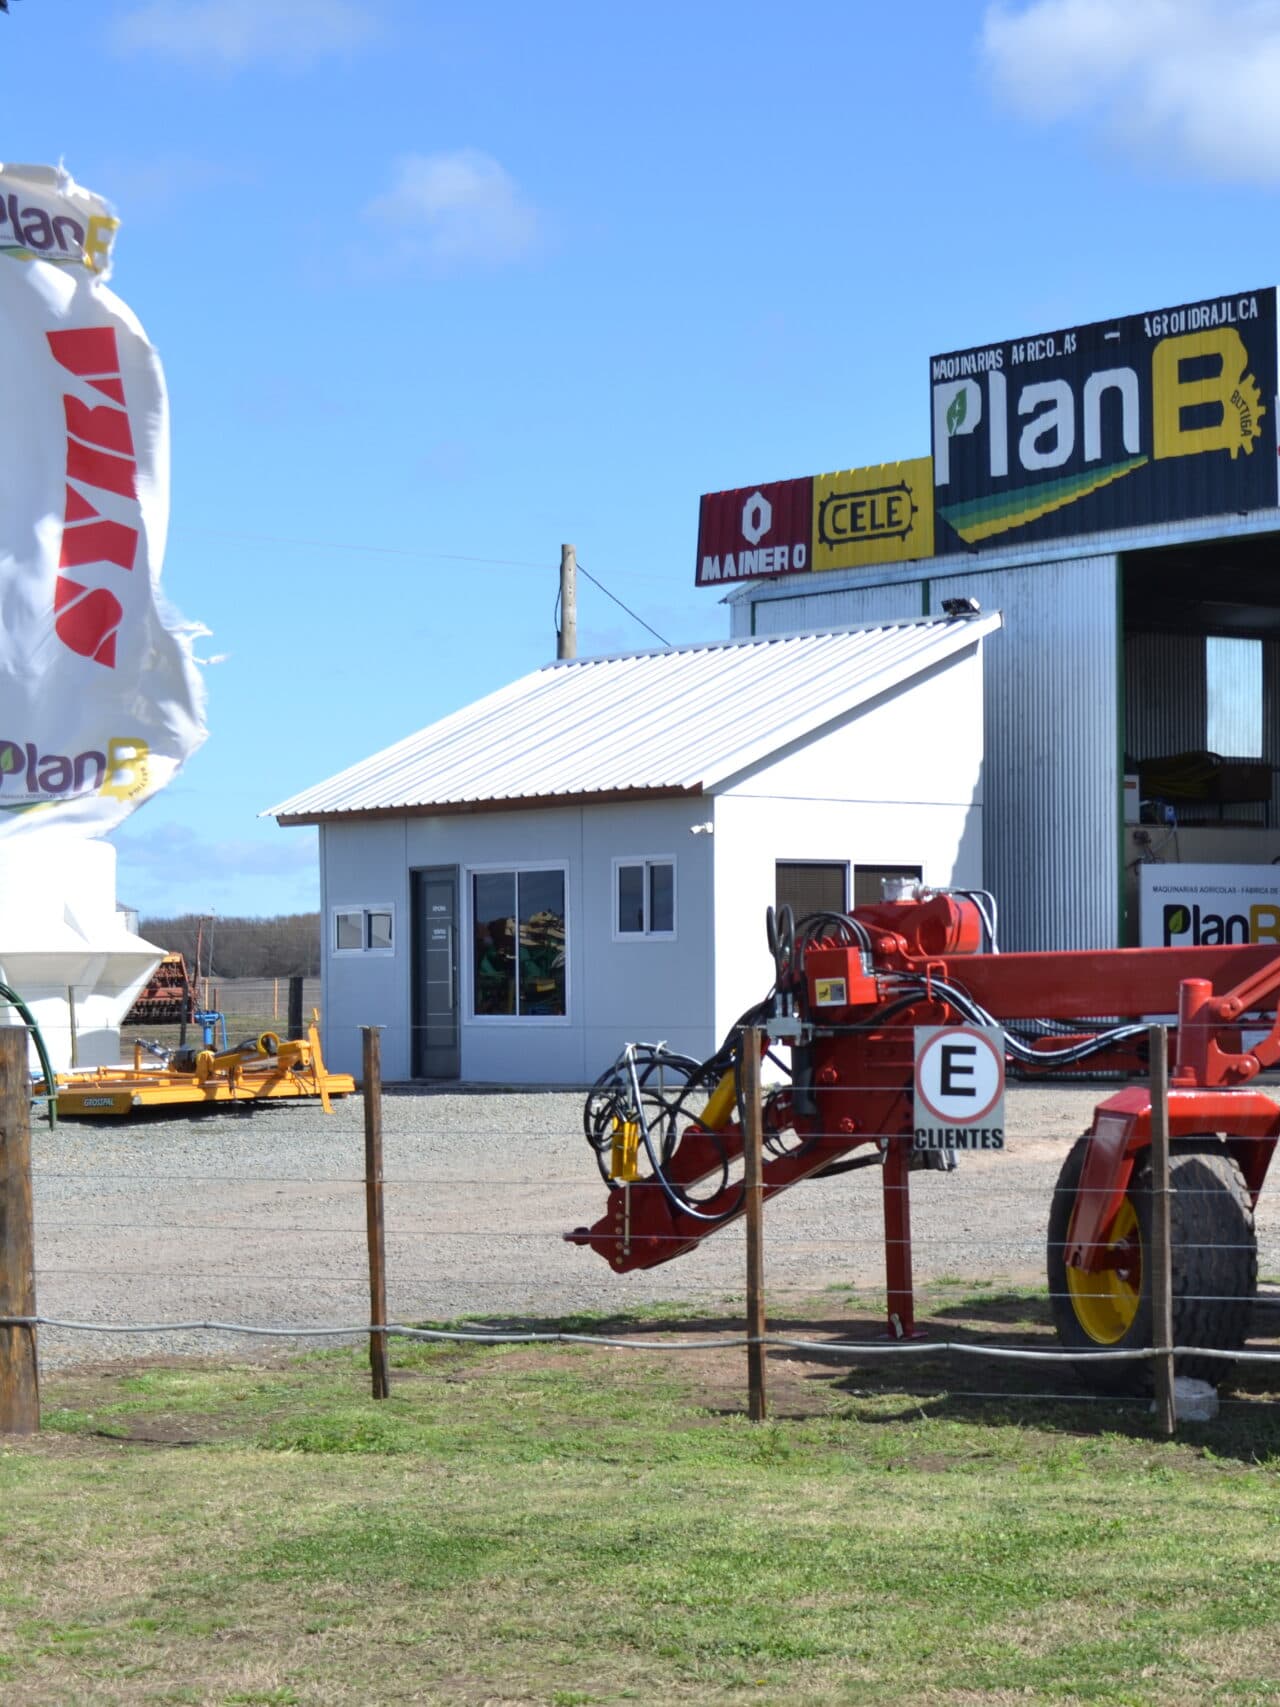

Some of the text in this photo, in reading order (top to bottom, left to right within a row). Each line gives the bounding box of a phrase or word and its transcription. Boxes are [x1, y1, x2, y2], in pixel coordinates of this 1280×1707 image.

[1011, 333, 1077, 365] AGRICOAS
[832, 496, 904, 534] CELE
[701, 543, 806, 581] MAINERO
[940, 1045, 976, 1097] E
[914, 1128, 1004, 1149] CLIENTES
